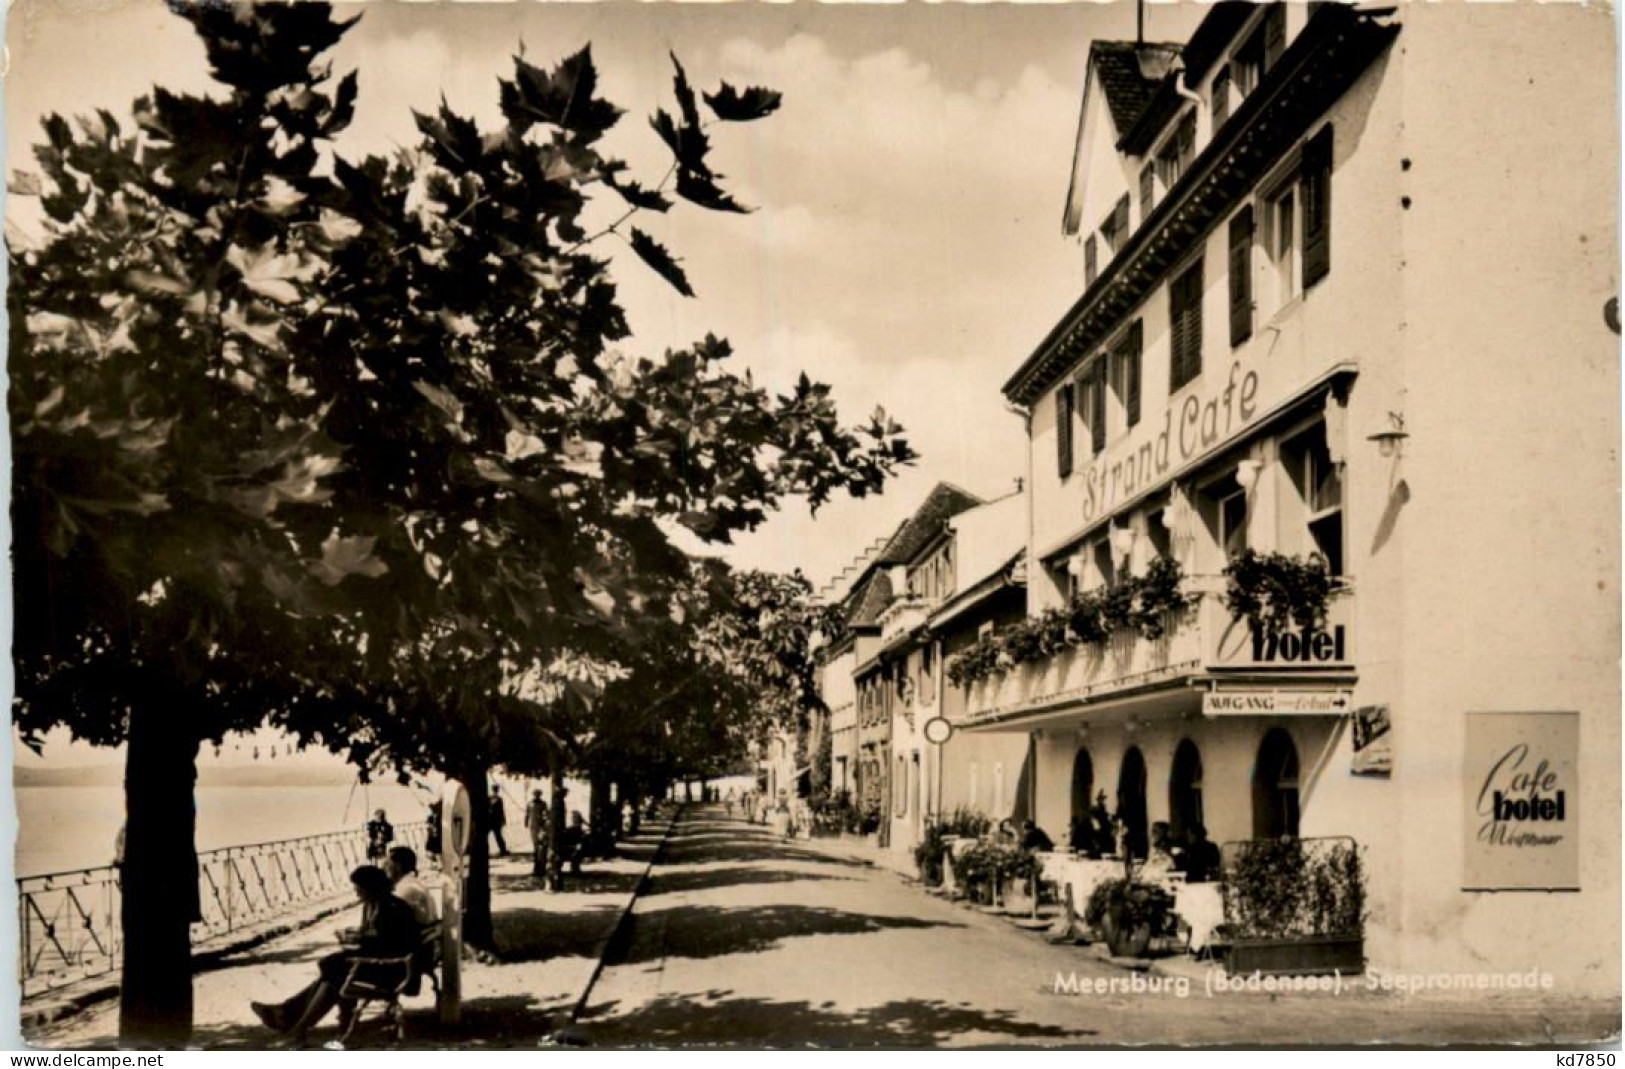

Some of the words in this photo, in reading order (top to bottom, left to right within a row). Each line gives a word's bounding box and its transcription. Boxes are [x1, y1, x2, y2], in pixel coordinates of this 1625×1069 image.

[1082, 407, 1171, 521] Strand
[1179, 361, 1258, 461] Cafe
[1208, 696, 1275, 710] AUFGANG
[1477, 743, 1558, 817] Cafe
[1493, 790, 1565, 820] hotel
